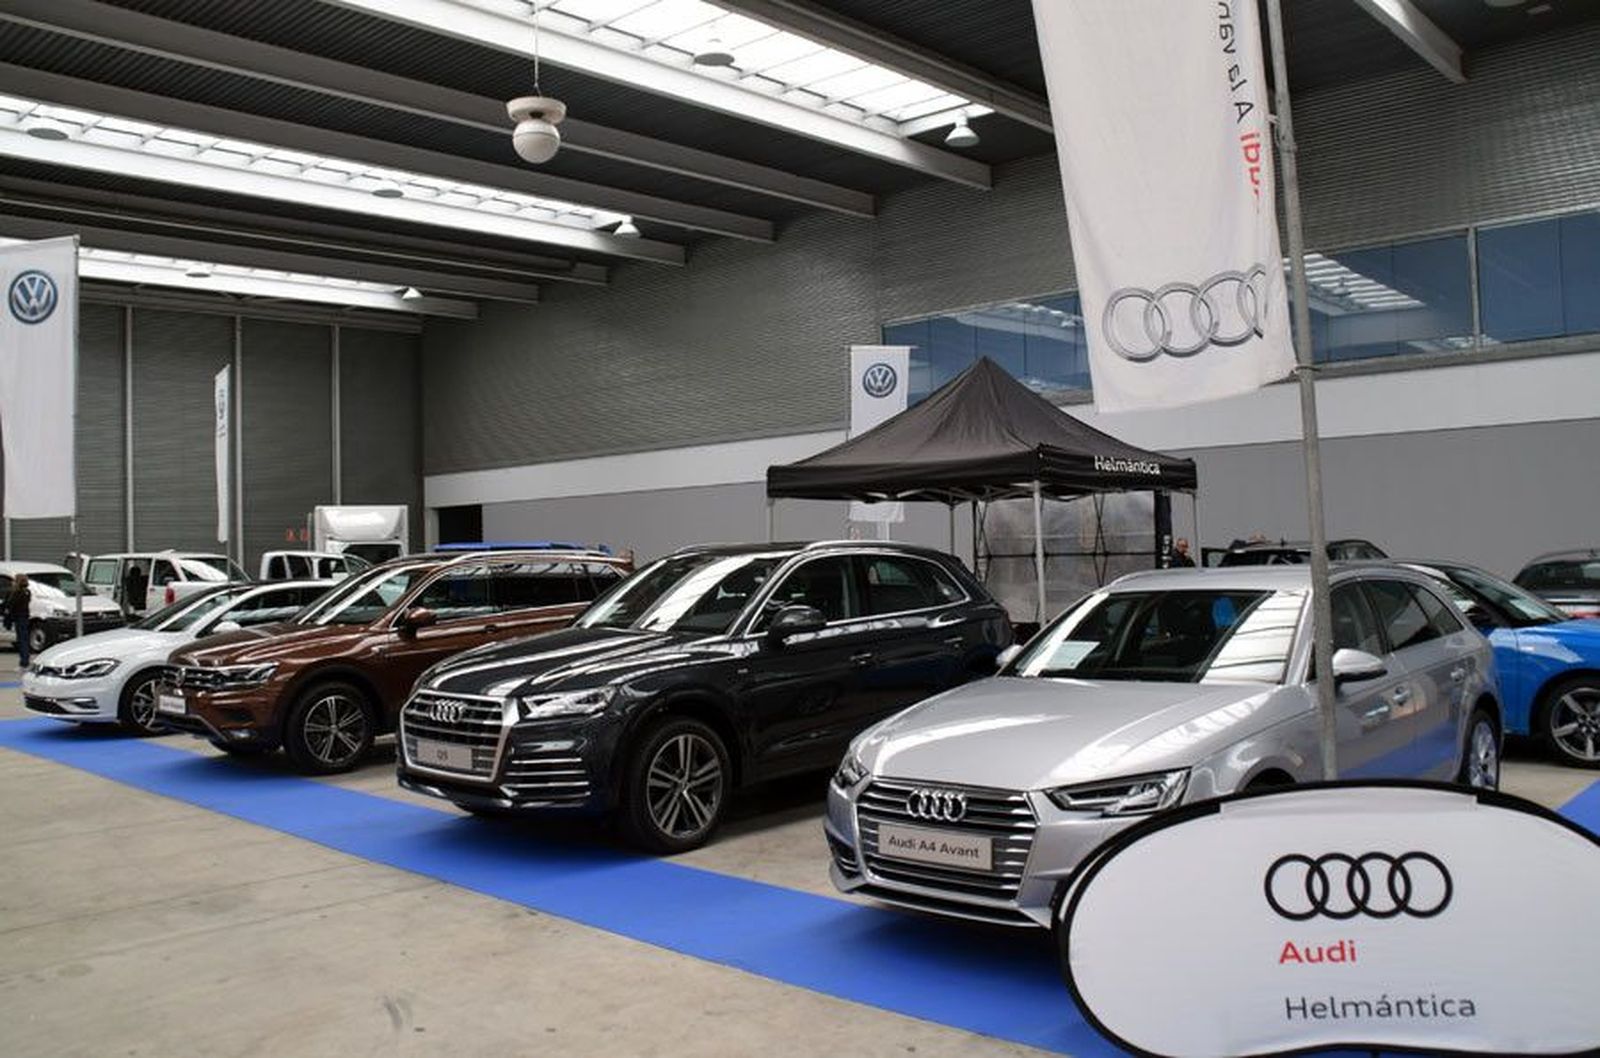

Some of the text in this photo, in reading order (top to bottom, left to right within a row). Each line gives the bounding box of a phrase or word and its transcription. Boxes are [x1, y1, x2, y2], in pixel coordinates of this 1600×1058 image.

[888, 836, 981, 859] Audi A4 Avant
[1279, 940, 1357, 964] Audi
[1285, 994, 1476, 1020] Helmántica
